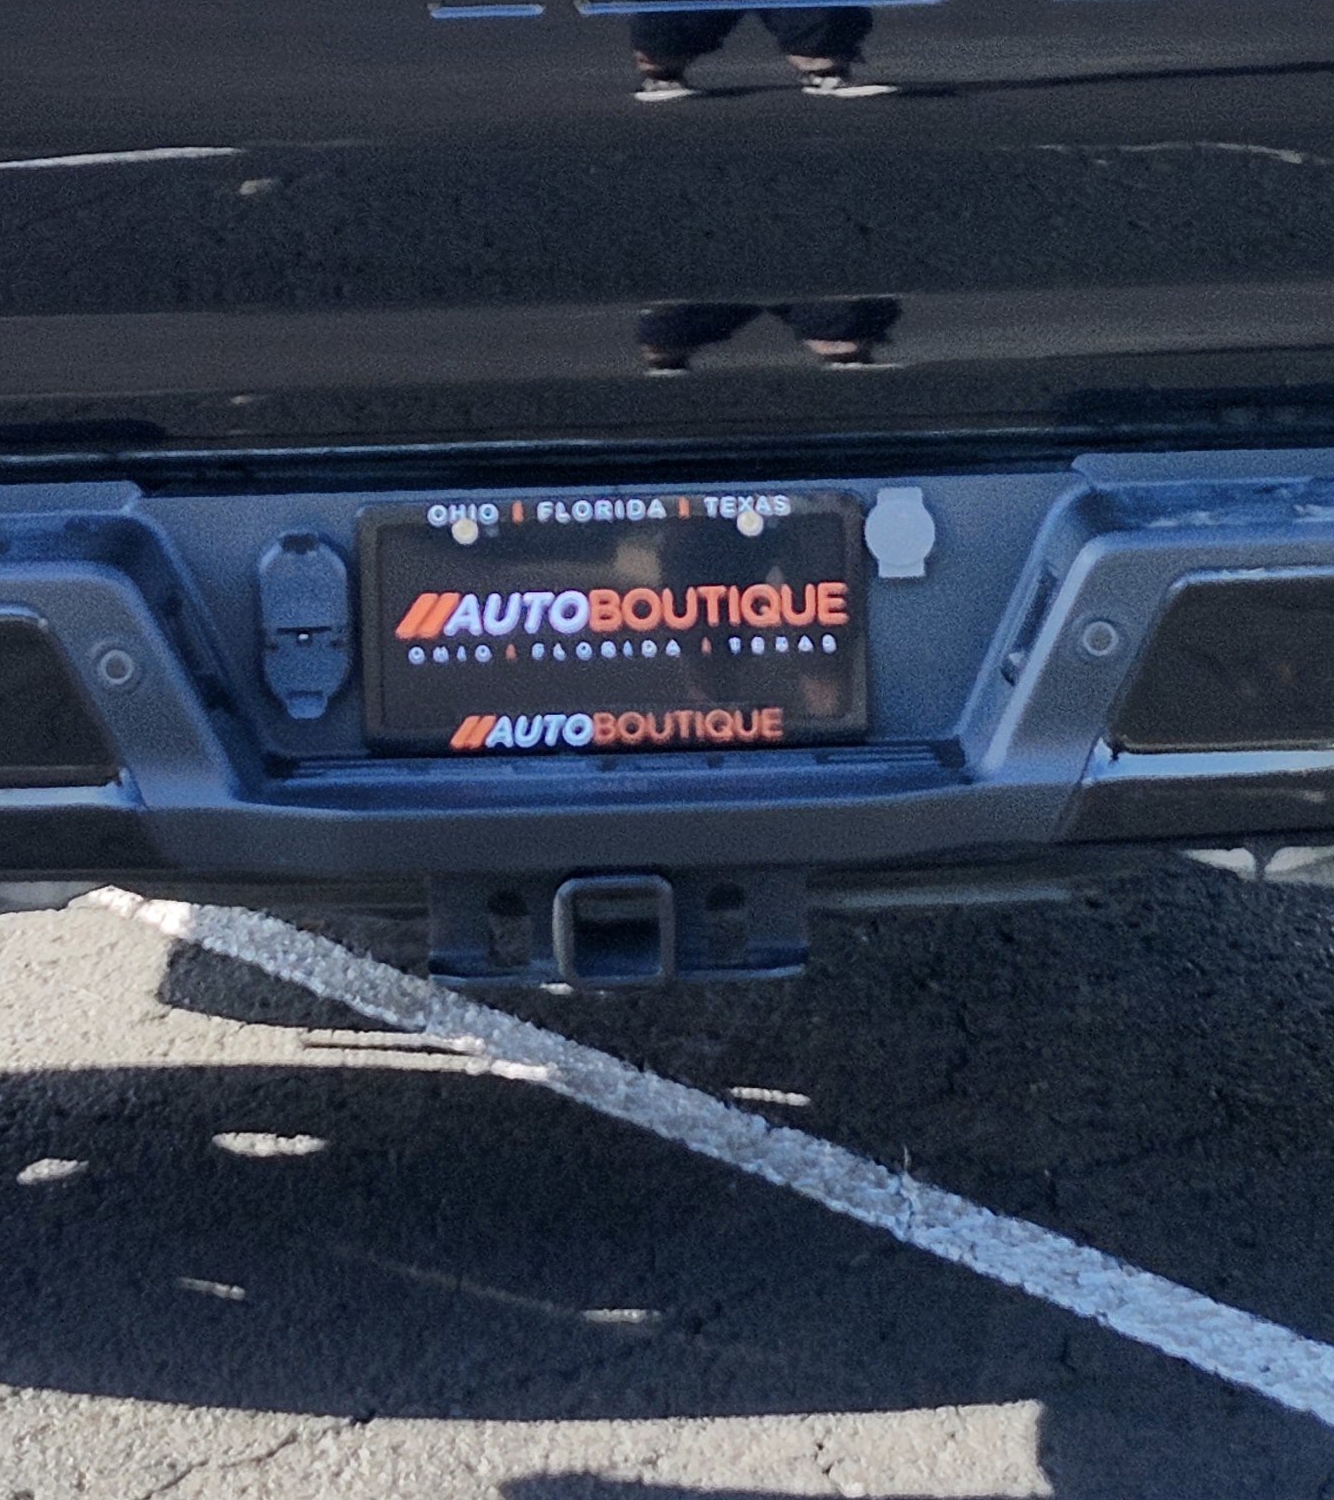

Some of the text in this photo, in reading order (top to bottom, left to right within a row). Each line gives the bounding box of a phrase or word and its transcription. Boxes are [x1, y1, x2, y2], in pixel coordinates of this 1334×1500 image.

[427, 495, 792, 527] OHIO FLORIDA TEXAS
[443, 581, 849, 637] AUTOBOUTIQUE
[485, 707, 785, 750] AUTOBOUTIQUE
